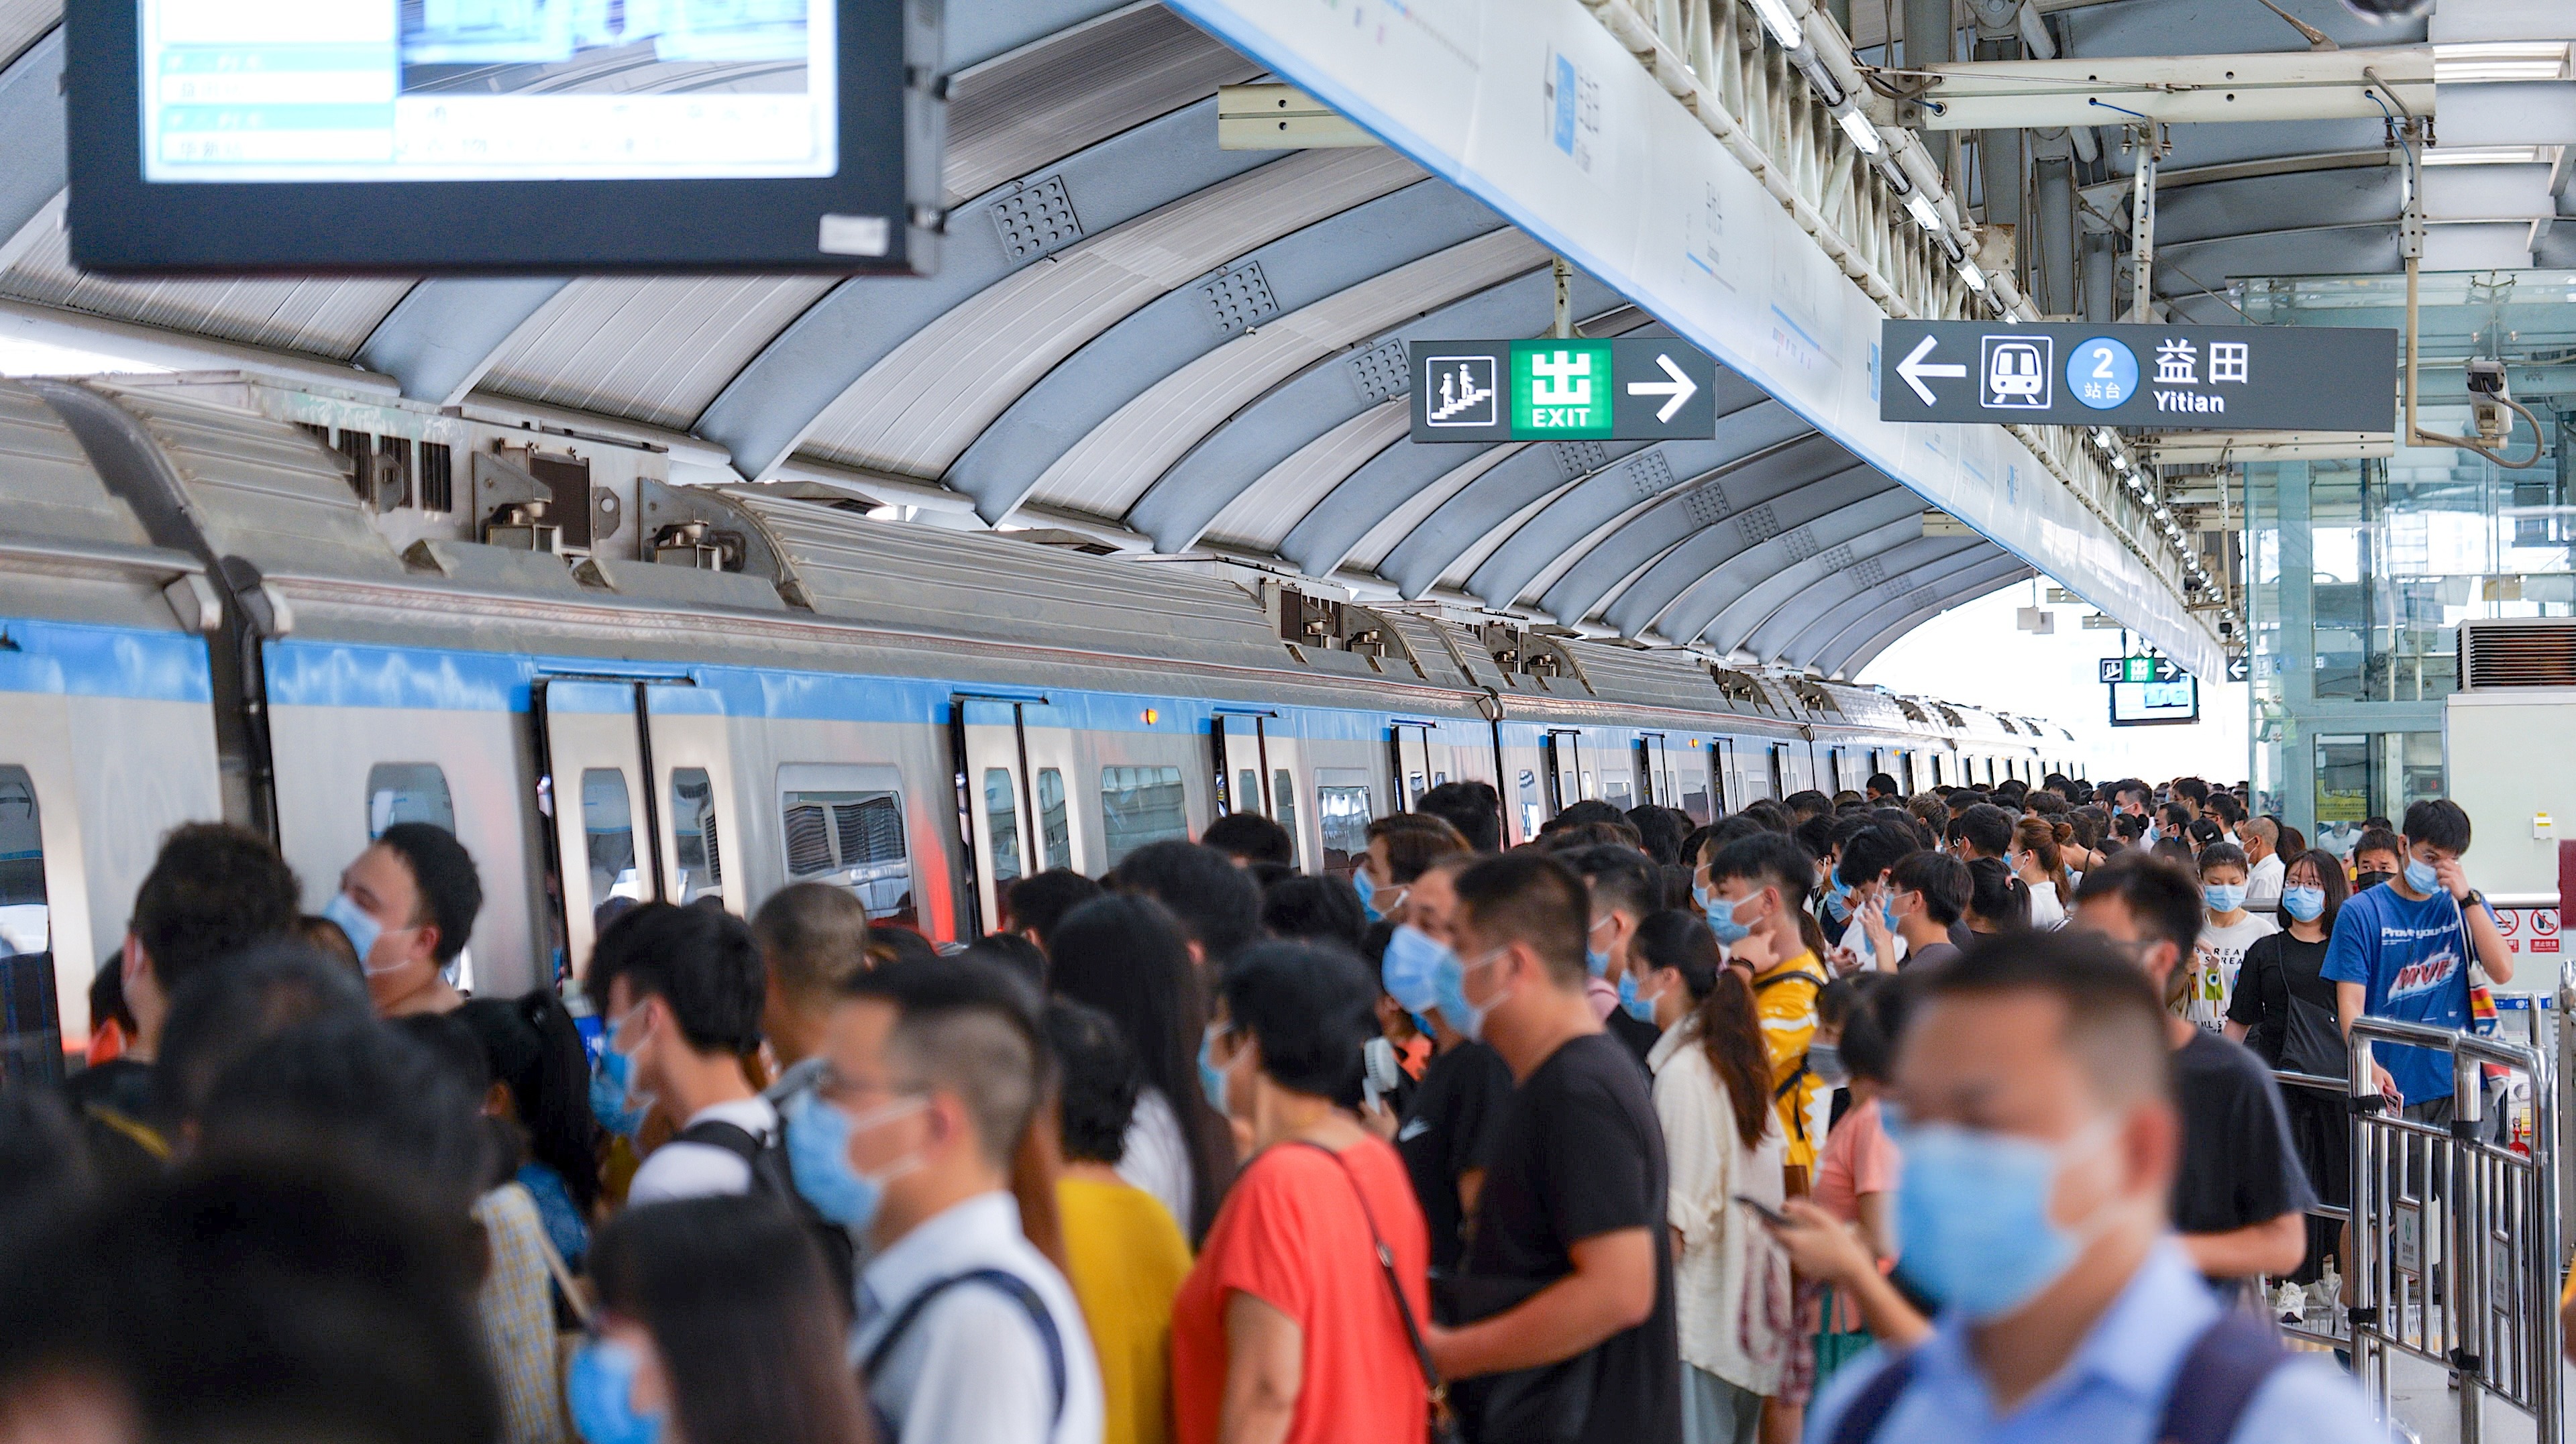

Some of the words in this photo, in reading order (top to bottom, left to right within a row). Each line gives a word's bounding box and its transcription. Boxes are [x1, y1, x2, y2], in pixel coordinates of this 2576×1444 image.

[2092, 347, 2114, 378] 2
[2153, 338, 2248, 384] 益田
[1532, 351, 1591, 405] 出
[2084, 382, 2121, 400] 站台
[2152, 390, 2224, 413] Yitian
[1532, 408, 1592, 427] EXIT
[2381, 927, 2415, 937] Prove
